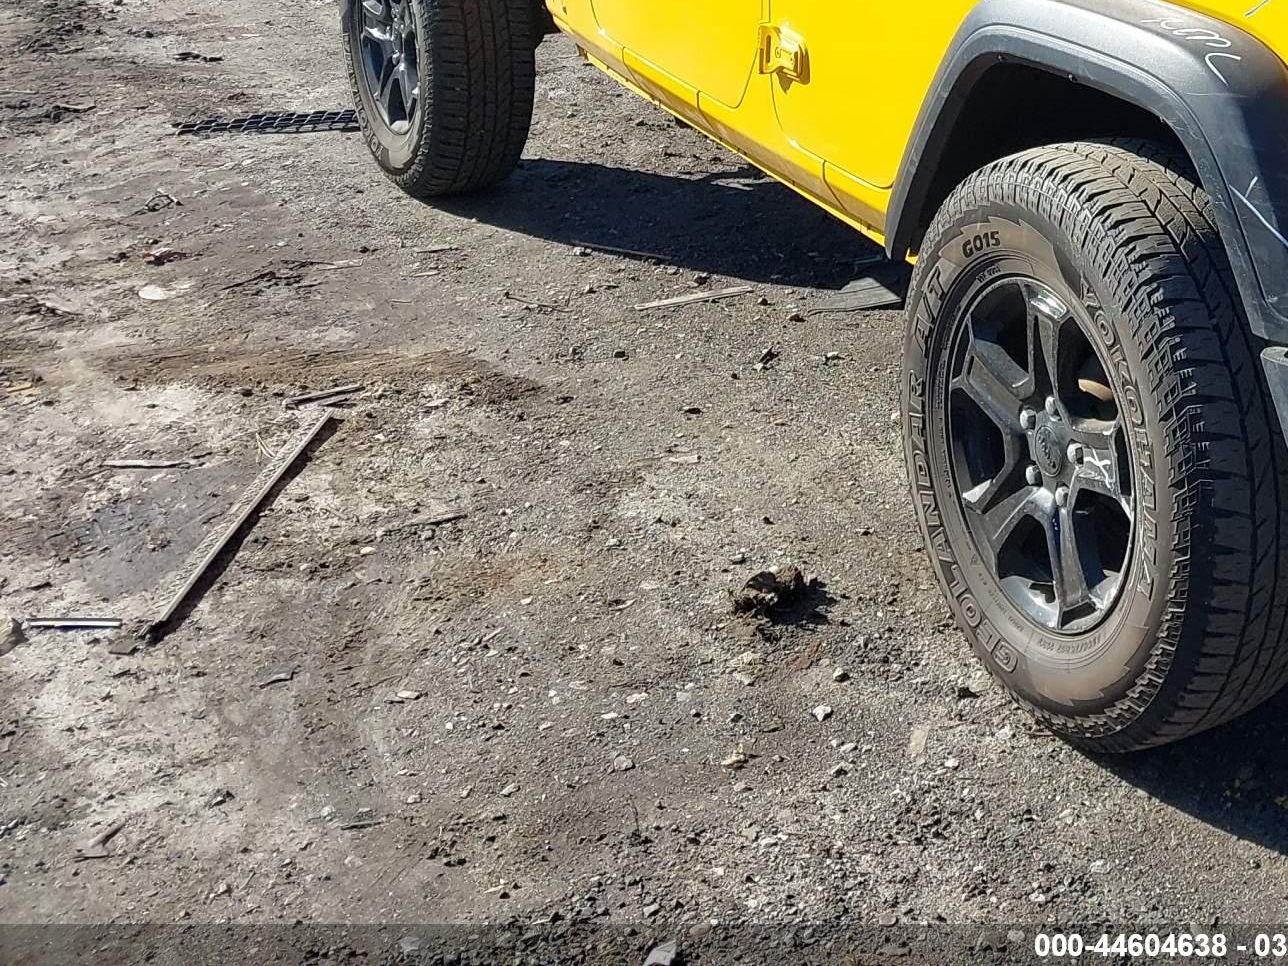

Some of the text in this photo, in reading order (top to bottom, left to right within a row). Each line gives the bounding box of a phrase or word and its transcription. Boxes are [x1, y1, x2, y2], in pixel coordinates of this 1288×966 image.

[914, 264, 949, 356] A/T
[1079, 277, 1158, 601] YOKOHAMA
[907, 369, 1019, 674] GEOLANDAR
